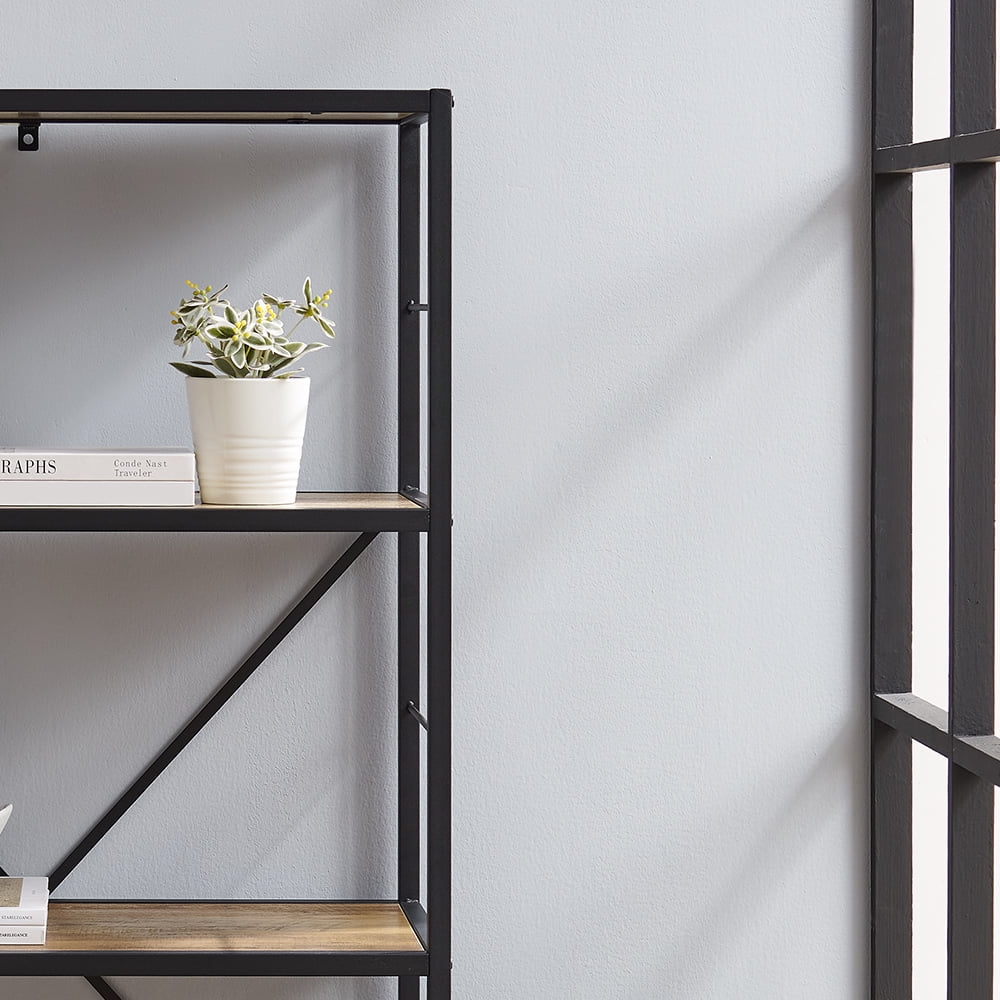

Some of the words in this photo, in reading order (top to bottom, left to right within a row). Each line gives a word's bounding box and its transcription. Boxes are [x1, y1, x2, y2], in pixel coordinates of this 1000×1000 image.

[113, 459, 142, 468] Conde
[145, 459, 168, 468] Nast
[114, 469, 153, 477] Traveler
